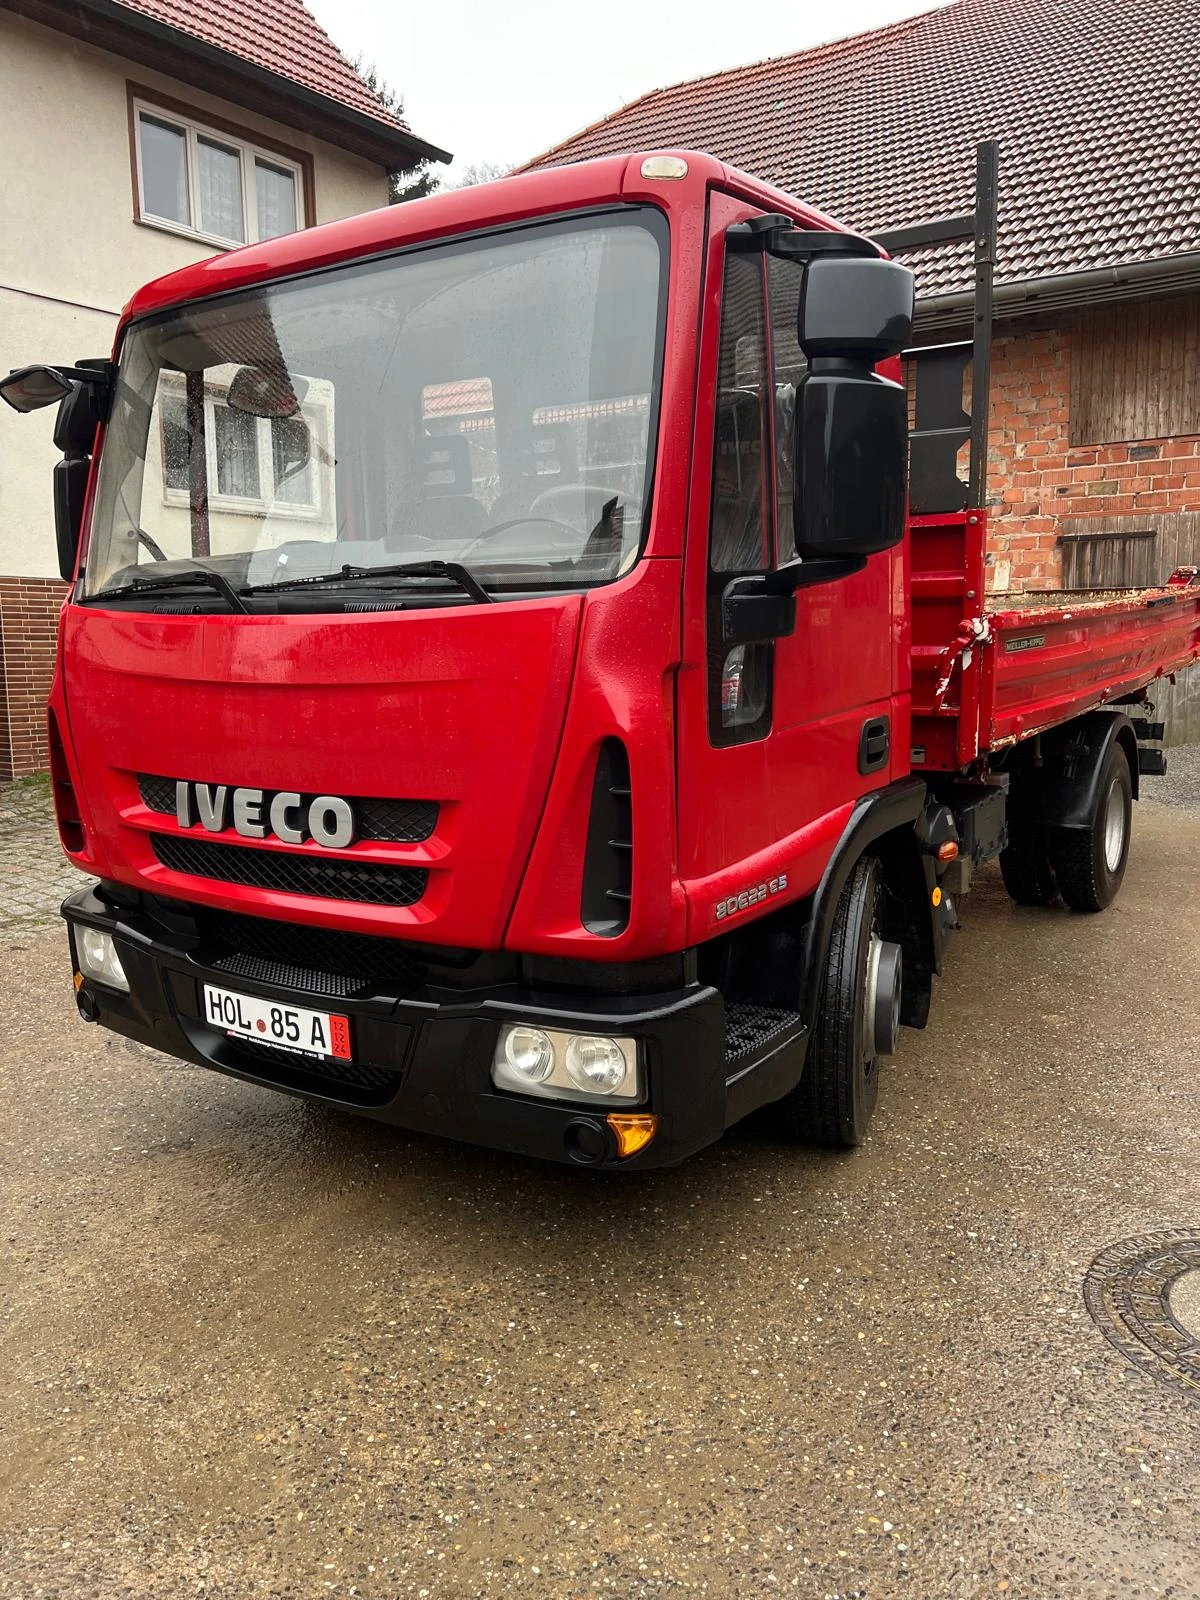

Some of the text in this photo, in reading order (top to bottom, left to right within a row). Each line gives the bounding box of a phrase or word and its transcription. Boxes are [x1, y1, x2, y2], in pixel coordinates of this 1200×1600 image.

[176, 781, 354, 848] IVECO
[209, 990, 327, 1048] HOL 85 A
[334, 1021, 344, 1031] 12
[335, 1032, 345, 1043] 12
[335, 1043, 346, 1054] 24
